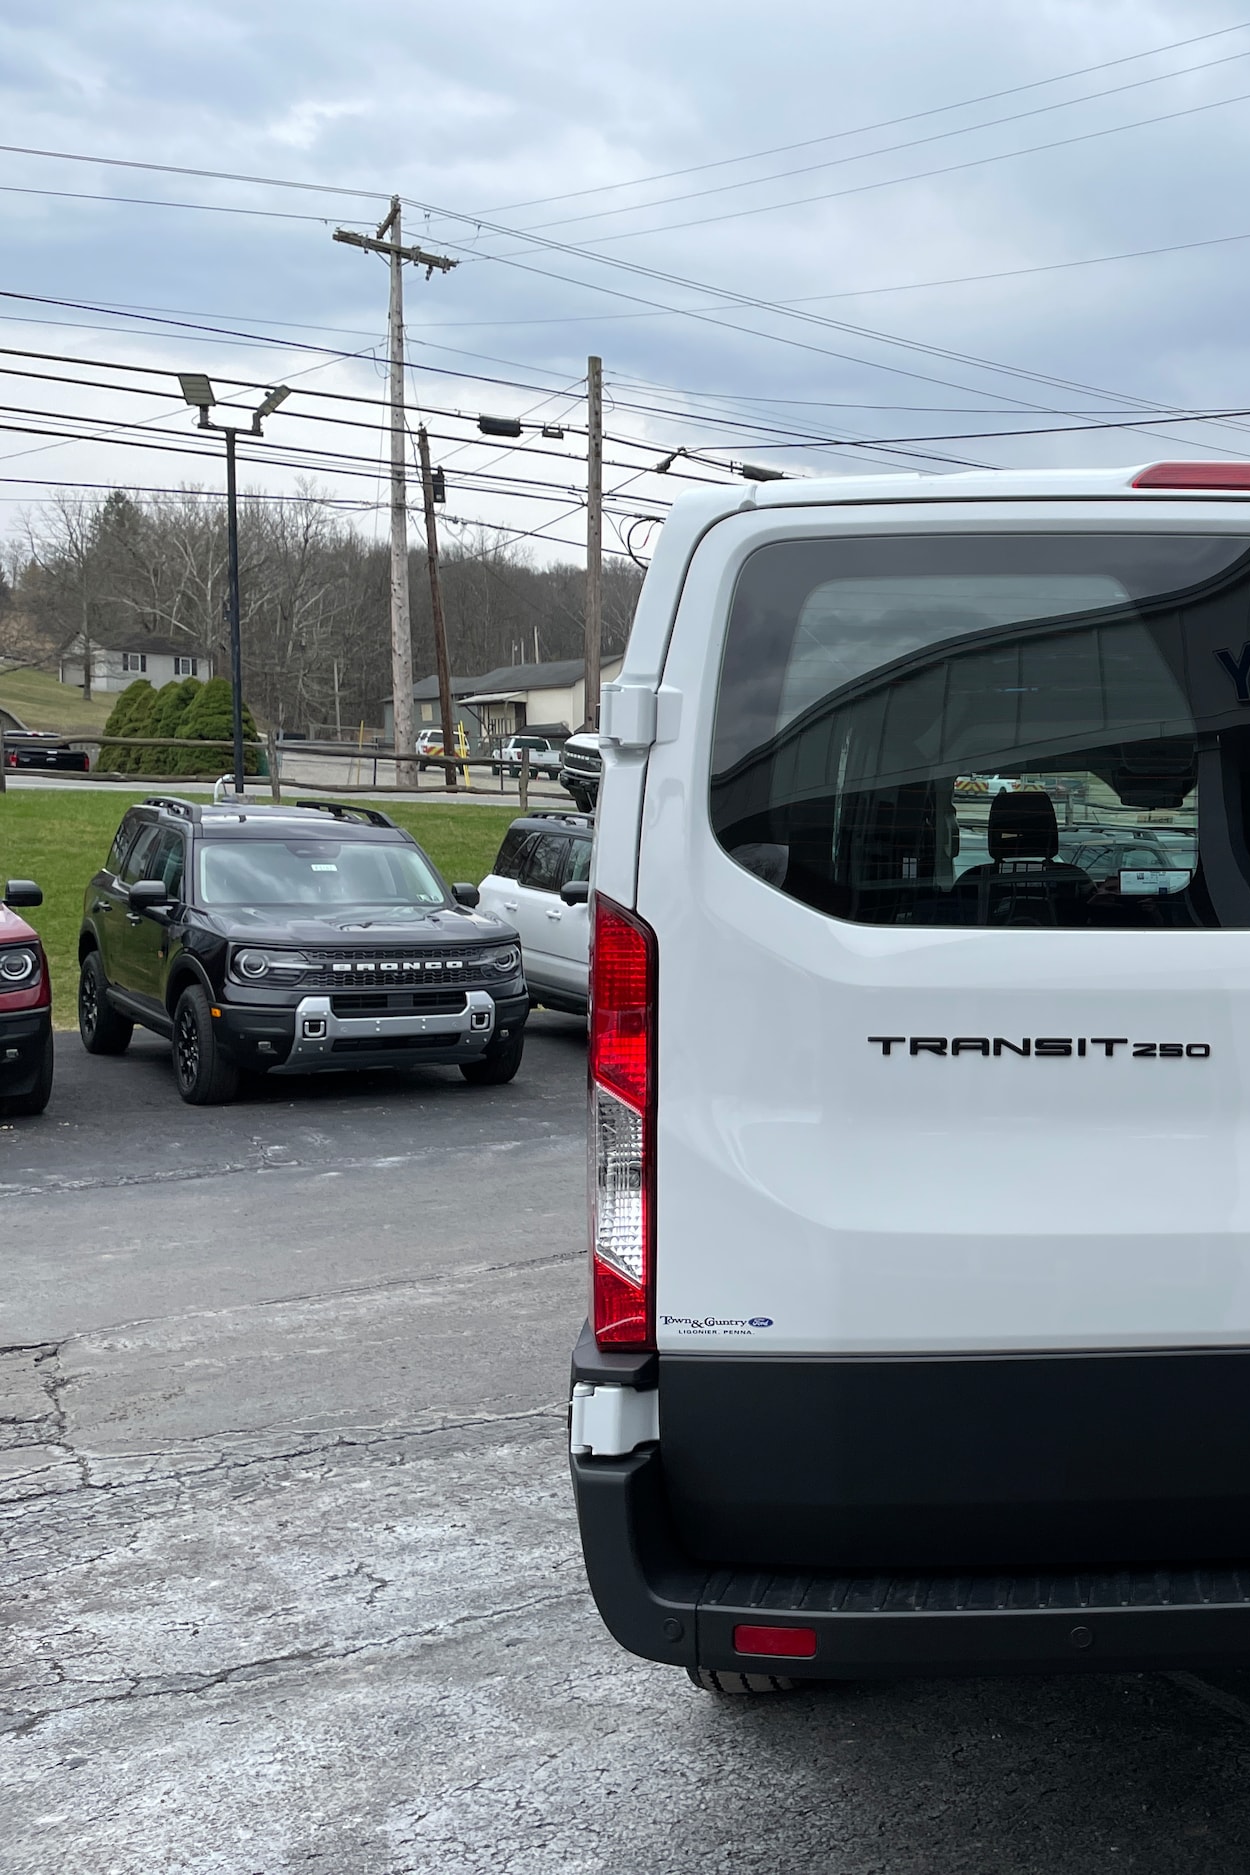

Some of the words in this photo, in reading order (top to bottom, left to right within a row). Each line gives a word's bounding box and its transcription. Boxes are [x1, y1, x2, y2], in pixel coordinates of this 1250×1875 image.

[332, 960, 463, 972] BRONCO
[867, 1036, 1129, 1057] TRANSIT
[1131, 1042, 1211, 1058] 250
